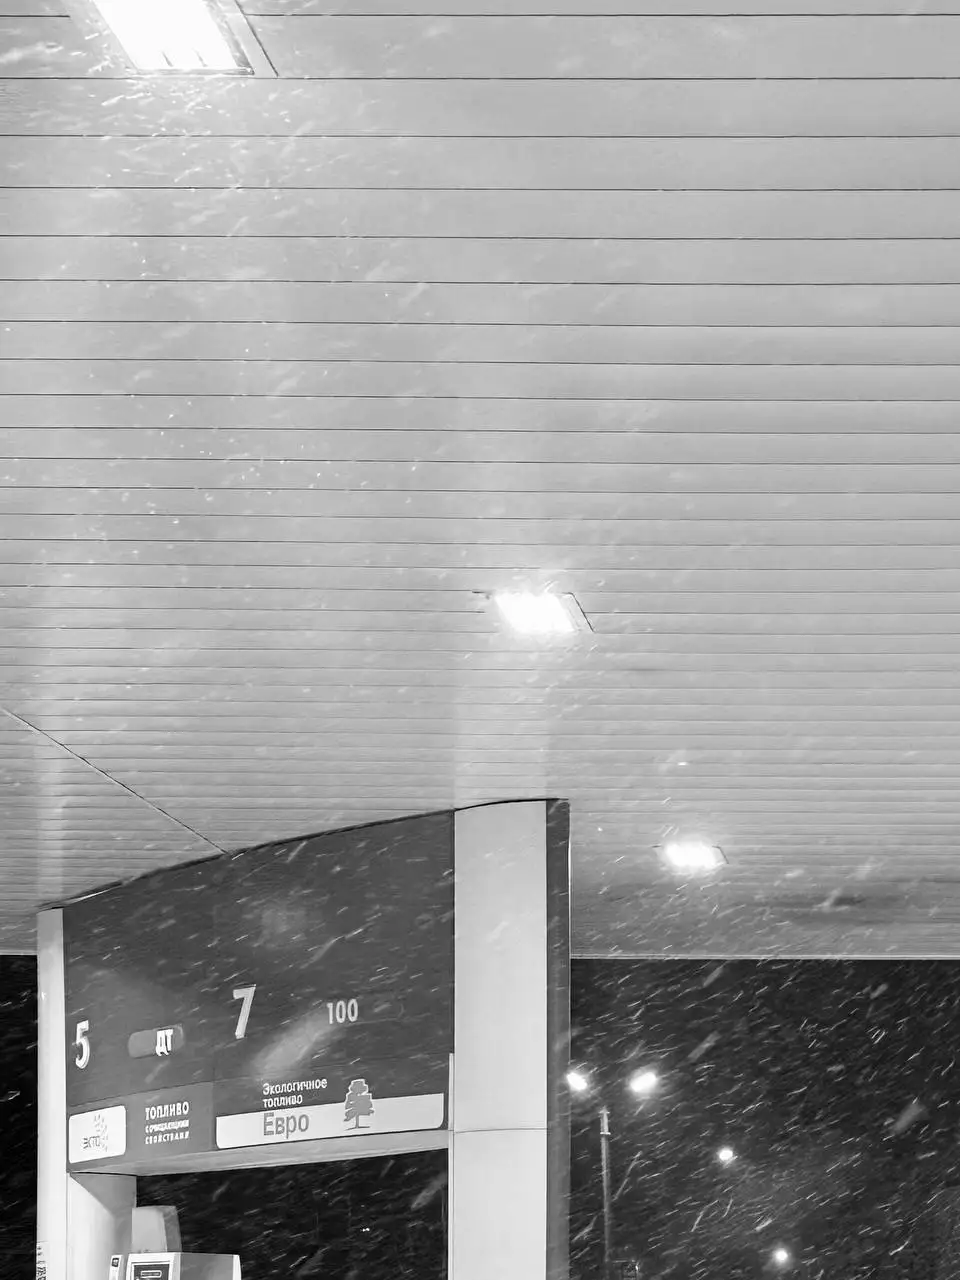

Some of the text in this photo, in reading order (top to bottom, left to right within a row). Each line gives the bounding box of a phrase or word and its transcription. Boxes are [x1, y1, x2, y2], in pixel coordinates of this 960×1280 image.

[233, 984, 256, 1039] 7
[327, 999, 358, 1024] 100
[75, 1020, 90, 1069] 5
[156, 1029, 173, 1056] ДТ
[264, 1112, 309, 1139] Евро
